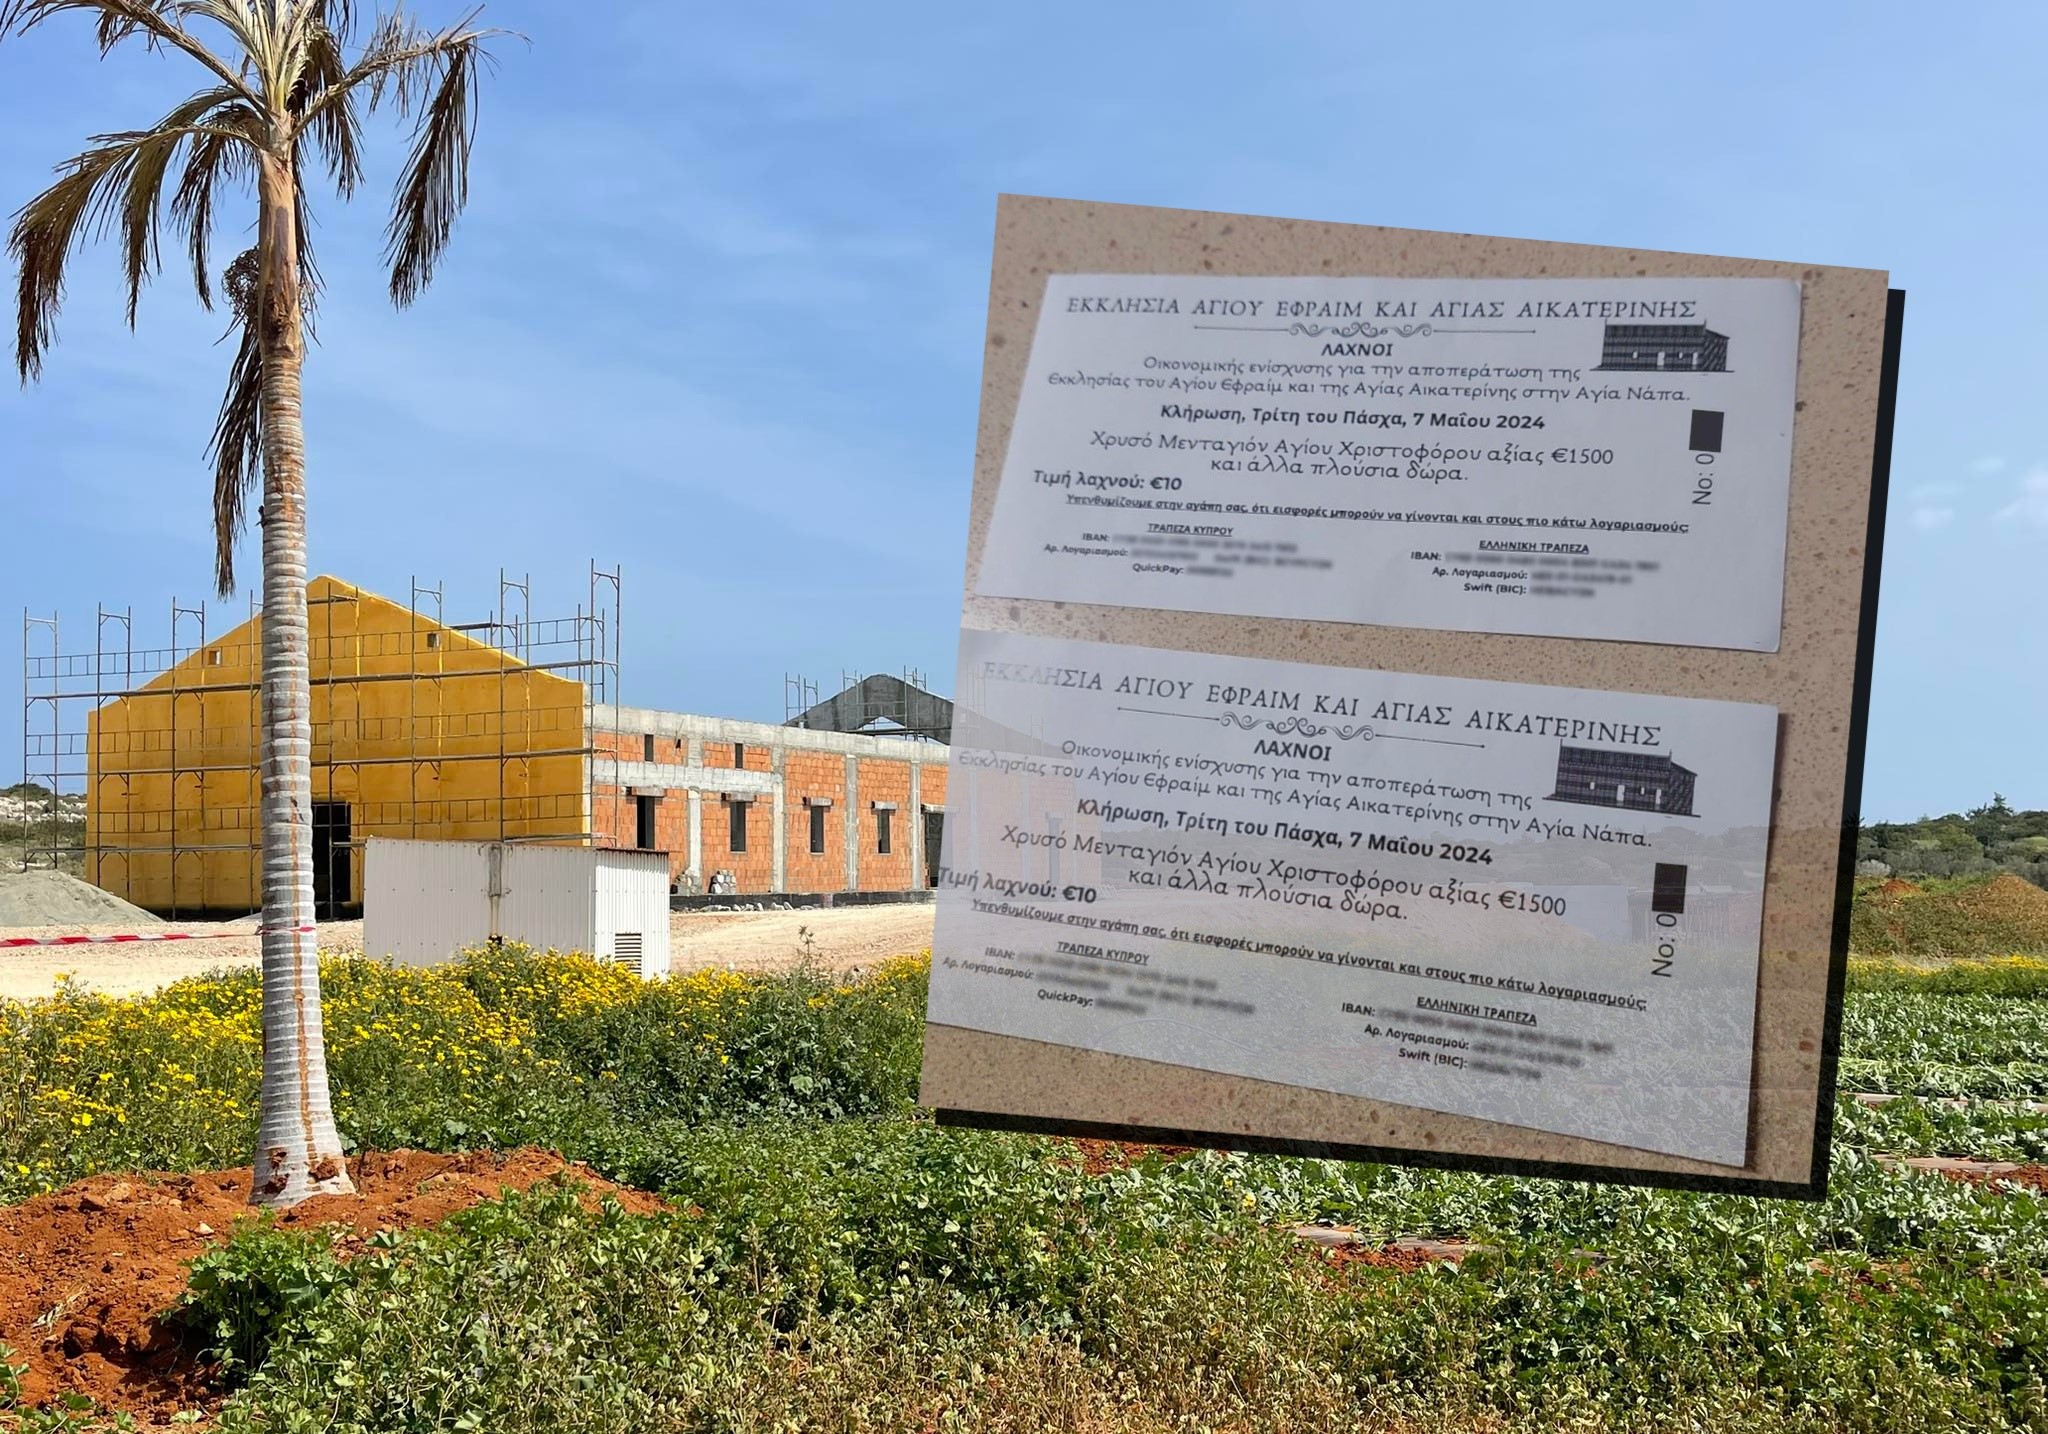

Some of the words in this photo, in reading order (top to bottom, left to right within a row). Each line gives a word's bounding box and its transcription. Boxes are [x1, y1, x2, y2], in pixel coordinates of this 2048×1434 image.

[1067, 297, 1180, 314] ΕΚΚΛΗΣΙΑ
[1191, 300, 1263, 317] ΑΓΙΟΥ
[1276, 301, 1362, 317] ΕΦΡΑΙΜ
[1374, 302, 1417, 317] ΚΑΙ
[1429, 301, 1505, 318] ΑΓΙΑΣ
[1517, 301, 1696, 318] ΑΙΚΑΤΕΡΙΝΗΣ
[1321, 344, 1393, 356] ΛΑΧΝΟΙ
[1144, 356, 1244, 375] Οικονομικής
[1250, 360, 1332, 377] ενίσχυσης
[1338, 365, 1365, 378] για
[1371, 366, 1403, 377] την
[1408, 363, 1542, 381] αποπεράτωση
[1549, 368, 1581, 381] της
[1136, 378, 1165, 388] του
[1169, 377, 1217, 393] Αγίου
[1289, 384, 1315, 393] και
[1320, 385, 1349, 397] της
[1354, 384, 1403, 397] Αγίας
[1409, 383, 1517, 401] Αικατερίνης
[1522, 388, 1570, 402] στην
[1575, 385, 1621, 403] Αγία
[1627, 385, 1690, 401] Νάπα.
[1161, 405, 1246, 424] Κλήρωση,
[1253, 408, 1300, 426] Τρίτη
[1307, 413, 1337, 423] του
[1343, 410, 1407, 428] Πάσχα,
[1413, 413, 1424, 426] 7
[1496, 415, 1545, 429] 2024
[1090, 430, 1153, 450] Χρυσό
[1159, 435, 1268, 455] Μενταγιόν
[1274, 438, 1332, 458] Αγίου
[1338, 441, 1481, 463] Χριστοφόρου
[1487, 442, 1544, 465] αξίας
[1551, 449, 1614, 465] €1500
[1033, 469, 1071, 488] Τιμή
[1076, 472, 1144, 490] λαχνού:
[1150, 476, 1182, 490] €10
[1211, 459, 1241, 471] και
[1247, 455, 1304, 474] άλλα
[1311, 457, 1400, 478] πλούσια
[1406, 460, 1468, 484] δώρα.
[1156, 500, 1183, 511] στην
[1186, 500, 1222, 513] αγάπη
[1252, 503, 1270, 514] ότι
[1273, 504, 1328, 518] εισφορές
[1330, 508, 1384, 520] μπορούν
[1388, 512, 1402, 521] να
[1406, 510, 1458, 523] γίνονται
[1462, 515, 1482, 524] και
[1487, 516, 1523, 527] στους
[1526, 517, 1548, 526] πιο
[1552, 516, 1586, 528] κάτω
[1082, 533, 1110, 541] IBAN:
[1148, 523, 1191, 534] ΤΡΑΠΕΖΑ
[1194, 526, 1234, 535] ΚΥΠΡΟΥ
[1411, 552, 1441, 561] IBAN:
[1479, 540, 1537, 552] ΕΛΛΗΝΙΚΗ
[1540, 542, 1589, 553] ΤΡΑΠΕΖΑ
[1133, 563, 1184, 575] QuickPay:
[1432, 567, 1449, 577] Αρ.
[1452, 568, 1528, 581] Λογαριασμού:
[1463, 583, 1493, 594] Swift
[1496, 584, 1526, 595] (BIC):
[1115, 675, 1194, 699] ΑΓΙΟΥ
[1206, 684, 1301, 710] ΕΦΡΑΙΜ
[1313, 695, 1359, 716] ΚΑΙ
[1371, 700, 1452, 725] ΑΓΙΑΣ
[1465, 709, 1661, 746] ΑΙΚΑΤΕΡΙΝΗΣ
[1254, 740, 1332, 761] ΛΑΧΝΟΙ
[1062, 740, 1170, 770] Οικονομικής
[1175, 753, 1265, 779] ενίσχυσης
[1271, 766, 1300, 781] για
[1307, 770, 1342, 788] την
[1346, 774, 1491, 807] αποπεράτωση
[1498, 792, 1532, 811] της
[1052, 765, 1084, 779] του
[1088, 766, 1139, 785] Αγίου
[1217, 784, 1245, 798] και
[1250, 787, 1282, 805] της
[1287, 789, 1341, 811] Αγίας
[1346, 796, 1463, 826] Αικατερίνης
[1469, 813, 1520, 834] στην
[1526, 817, 1575, 840] Αγία
[1582, 823, 1652, 847] Νάπα.
[1078, 798, 1169, 828] Κλήρωση,
[1177, 810, 1227, 836] Τρίτη
[1235, 820, 1268, 835] του
[1274, 822, 1343, 848] Πάσχα,
[1350, 832, 1362, 846] 7
[1439, 843, 1493, 865] 2024
[1001, 825, 1066, 849] Χρυσό
[1073, 833, 1192, 866] Μενταγιόν
[1197, 851, 1261, 875] Αγίου
[1267, 859, 1423, 896] Χριστοφόρου
[1429, 878, 1491, 909] αξίας
[1498, 891, 1566, 916] €1500
[939, 866, 979, 891] Τιμή
[983, 872, 1057, 897] λαχνού:
[1063, 885, 1096, 903] €10
[1129, 870, 1162, 885] και
[1168, 868, 1228, 895] άλλα
[1237, 878, 1333, 909] πλούσια
[1340, 889, 1407, 920] δώρα.
[972, 899, 1064, 923] Υπενθυμίζουμε
[1067, 915, 1096, 928] στην
[1100, 917, 1138, 935] αγάπη
[1170, 928, 1190, 941] ότι
[1193, 933, 1253, 951] εισφορές
[1255, 941, 1314, 958] μπορούν
[1318, 952, 1333, 962] να
[1337, 952, 1395, 972] γίνονται
[1400, 964, 1423, 976] και
[1425, 967, 1466, 984] στους
[1469, 972, 1494, 985] πιο
[1498, 977, 1535, 993] κάτω
[1058, 941, 1103, 957] ΤΡΑΠΕΖΑ
[1106, 949, 1150, 964] ΚΥΠΡΟΥ
[1038, 988, 1093, 1007] QuickPay:
[1342, 1002, 1376, 1016] IBAN:
[1417, 997, 1480, 1016] ΕΛΛΗΝΙΚΗ
[1484, 1006, 1537, 1025] ΤΡΑΠΕΖΑ
[1364, 1023, 1383, 1037] Αρ.
[1385, 1027, 1469, 1050] Λογαριασμού:
[1399, 1048, 1430, 1062] Swift
[1434, 1054, 1467, 1069] (BIC):
